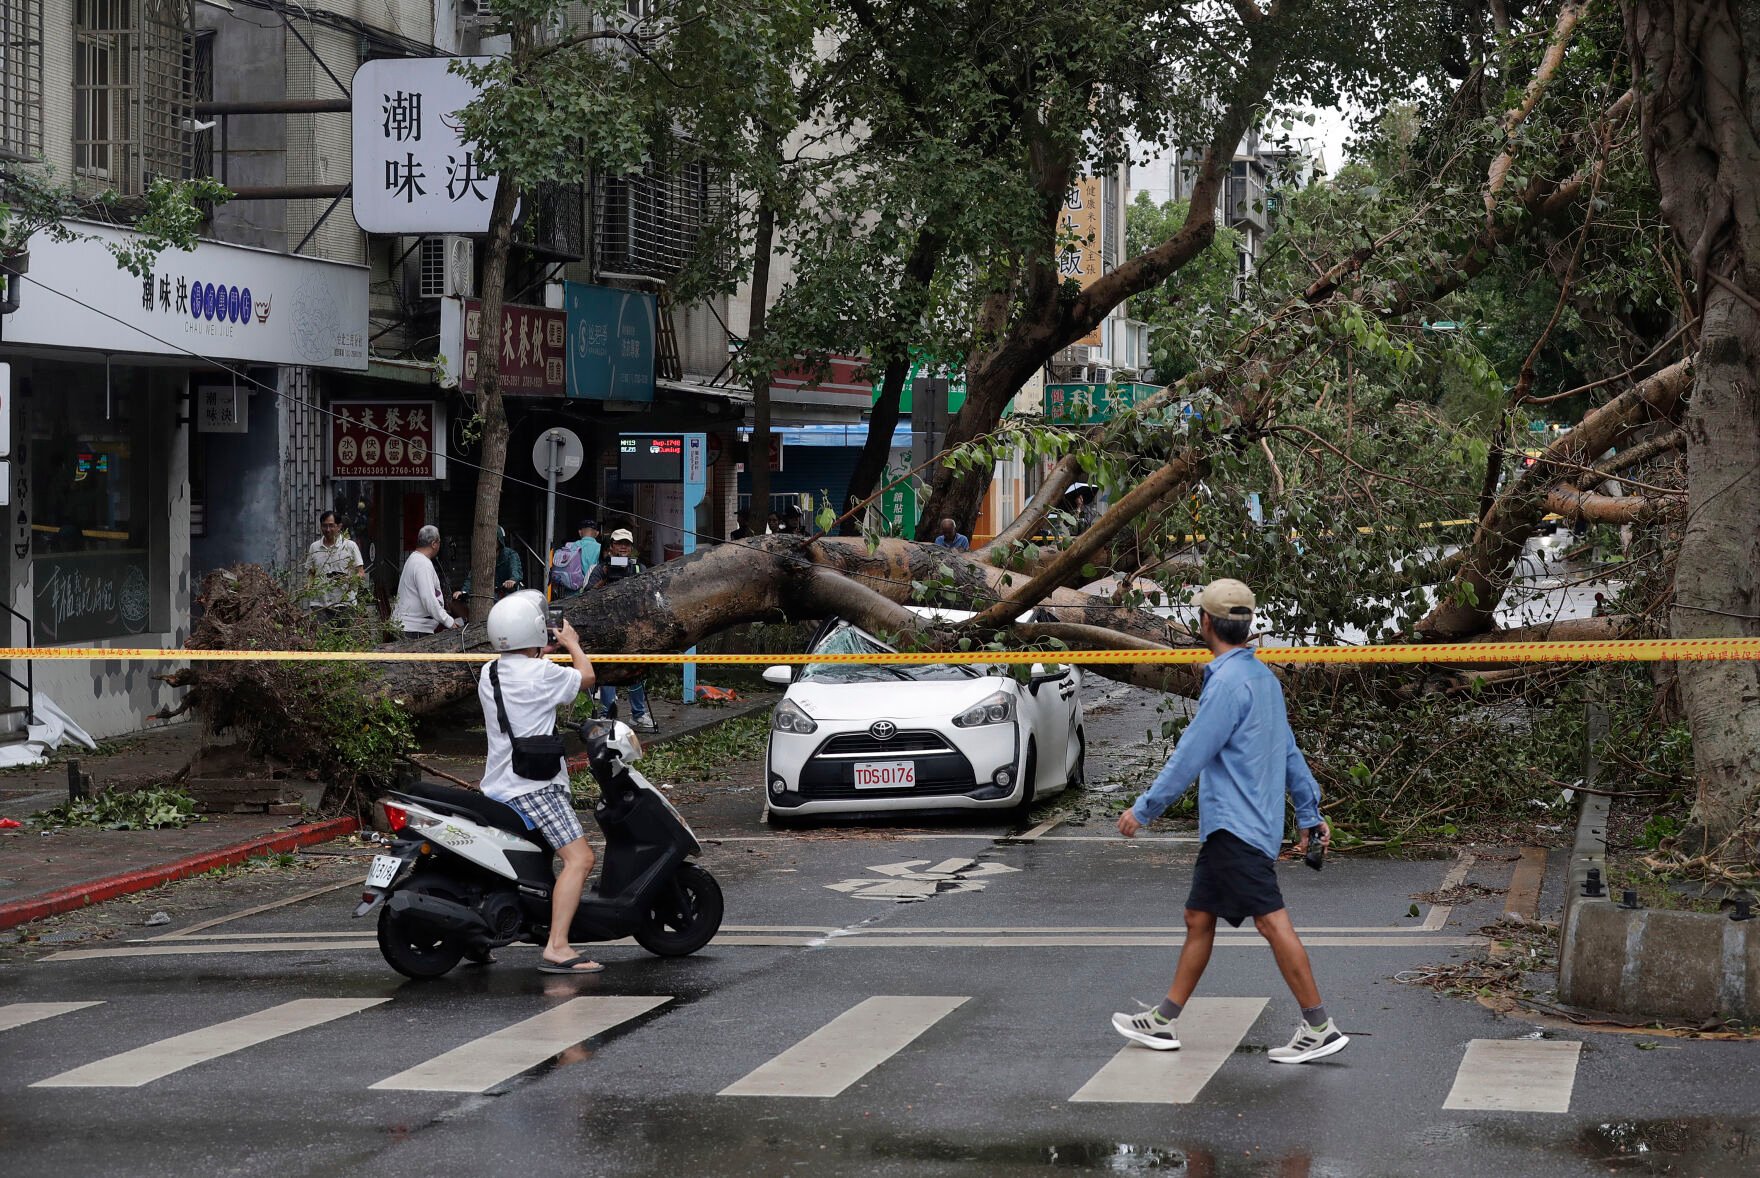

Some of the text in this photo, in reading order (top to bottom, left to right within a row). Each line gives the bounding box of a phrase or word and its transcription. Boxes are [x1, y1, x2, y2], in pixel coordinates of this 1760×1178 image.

[184, 321, 202, 334] CHAU
[503, 313, 544, 368] 米餐飲
[391, 467, 429, 475] 2760-1933
